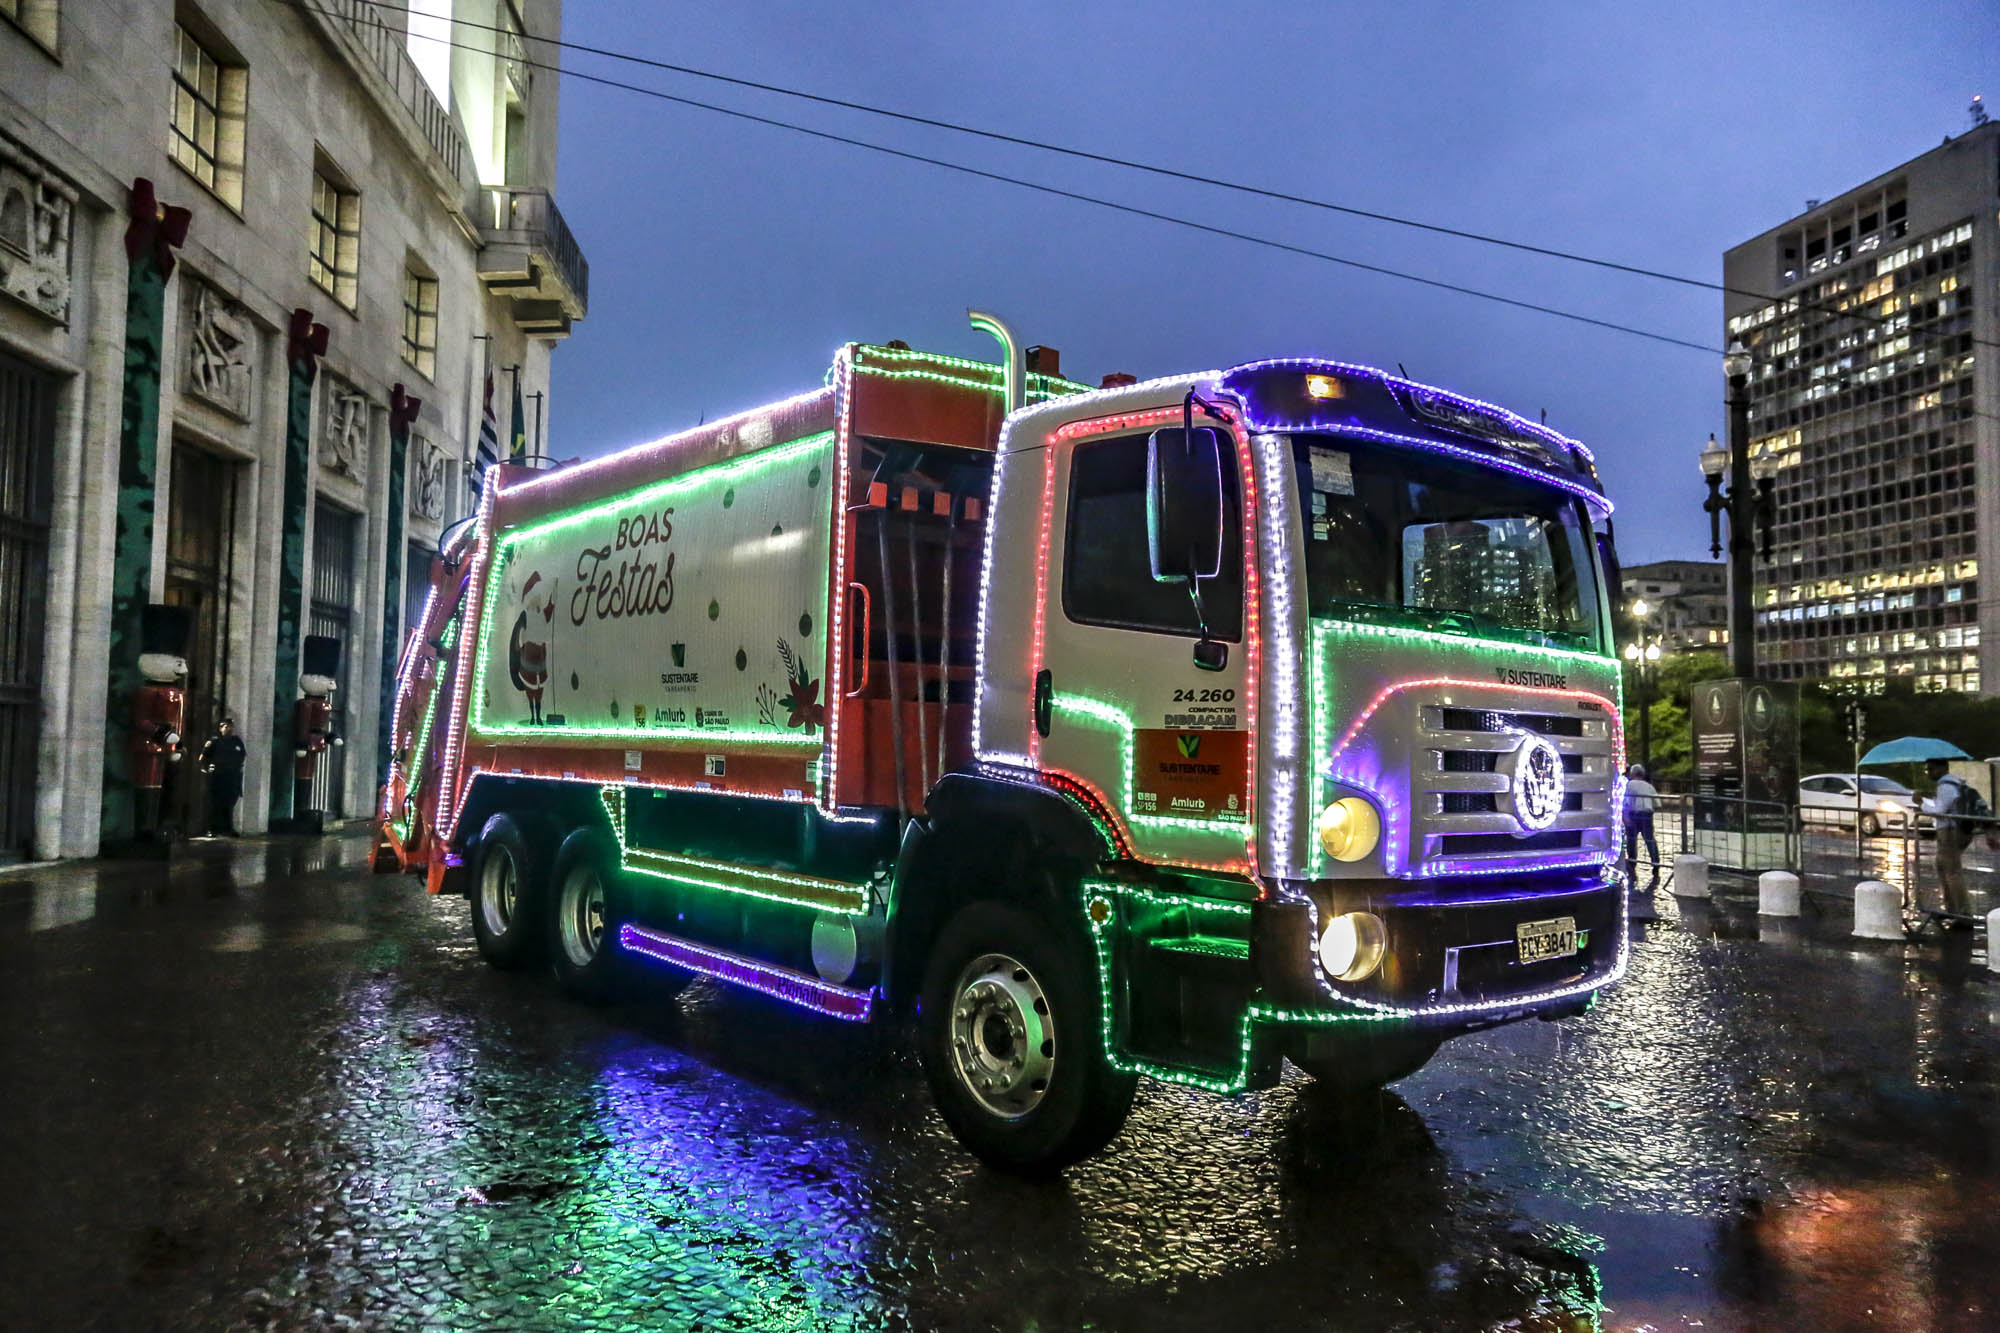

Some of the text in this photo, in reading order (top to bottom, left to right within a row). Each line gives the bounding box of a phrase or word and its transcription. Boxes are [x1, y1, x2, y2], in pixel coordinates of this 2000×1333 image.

[615, 507, 675, 552] BOAS
[570, 544, 675, 627] Festas
[661, 672, 700, 684] SUSTENTARE
[1508, 669, 1567, 689] SUSTENTARE
[1173, 688, 1236, 702] 24.260
[655, 707, 686, 722] Amlurb
[1164, 714, 1237, 726] DIBRACAM
[1159, 763, 1221, 776] SUSTENTARE
[1171, 796, 1206, 809] Amlurb
